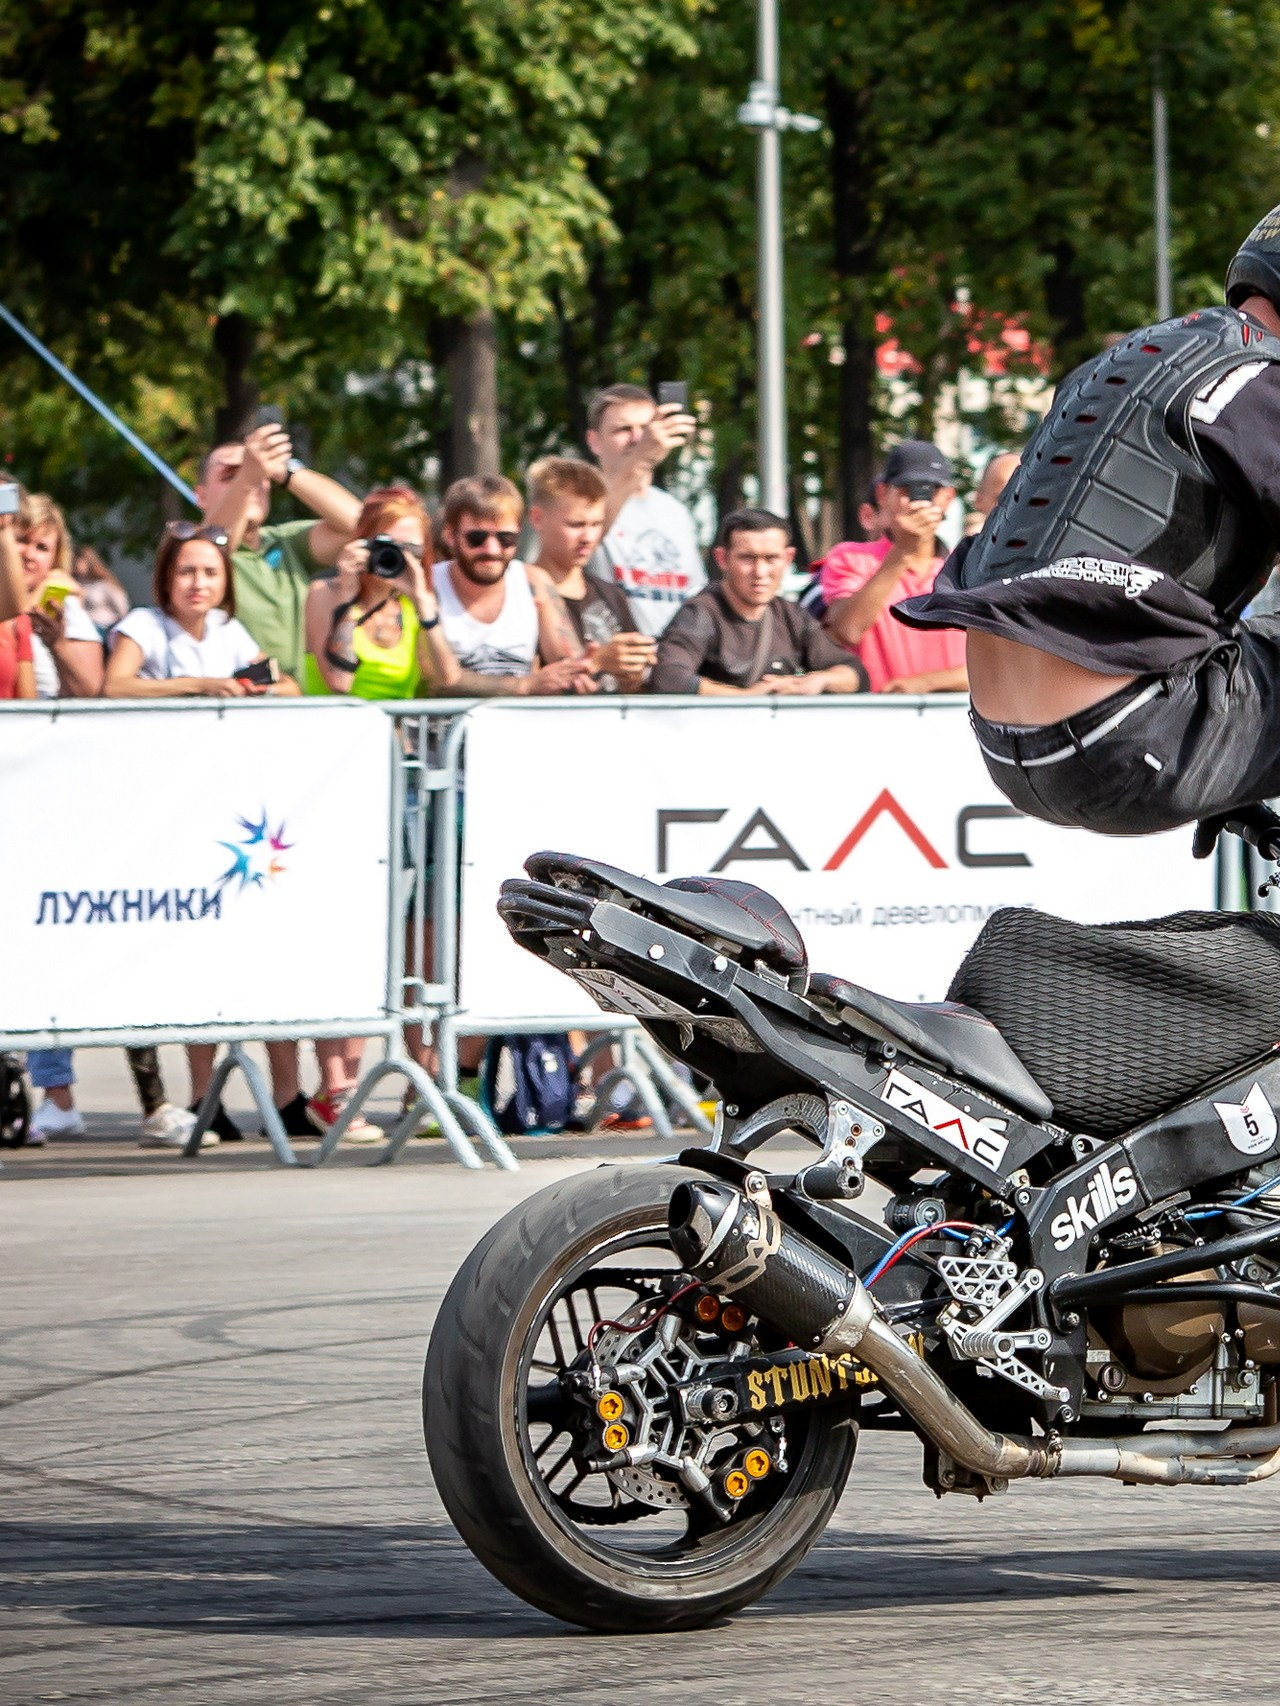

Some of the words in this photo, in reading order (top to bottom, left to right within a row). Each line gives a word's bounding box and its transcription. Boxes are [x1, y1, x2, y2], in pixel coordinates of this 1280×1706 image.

[656, 787, 1033, 873] ГАЛС
[35, 888, 223, 925] ЛУЖНИКИ
[1243, 1113, 1260, 1137] 5
[1050, 1162, 1138, 1252] skills
